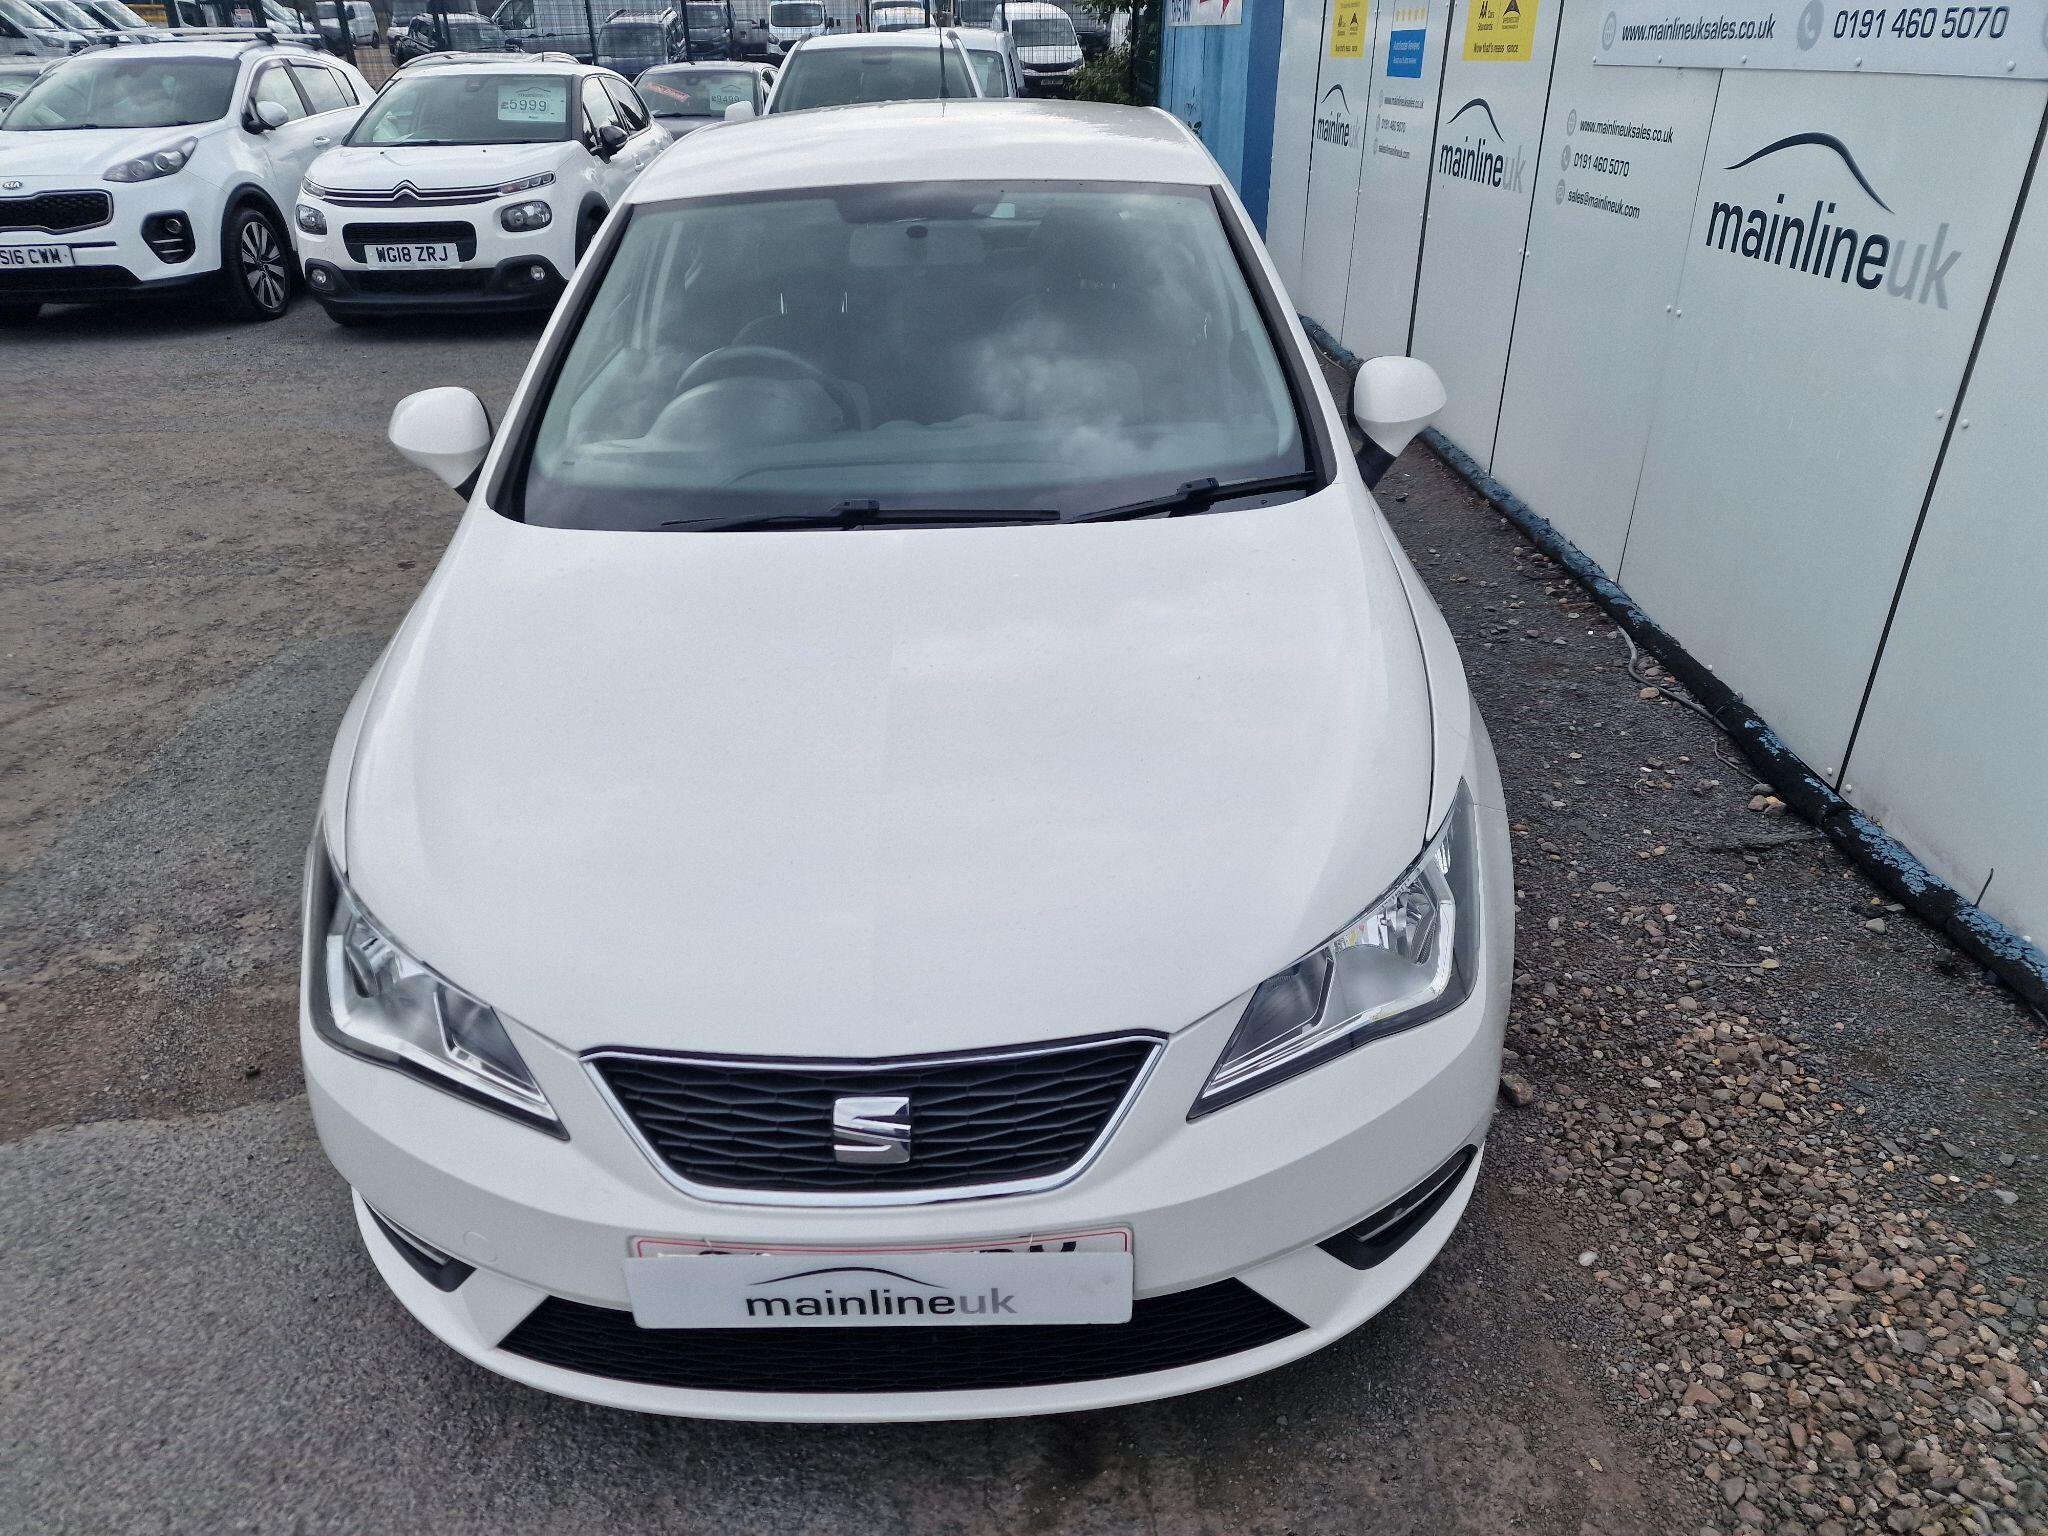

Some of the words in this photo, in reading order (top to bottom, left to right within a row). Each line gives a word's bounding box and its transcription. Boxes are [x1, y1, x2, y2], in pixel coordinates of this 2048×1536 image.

[1621, 13, 1776, 42] www.mainlineuksales.co.uk
[1833, 8, 1887, 39] 0191
[1891, 7, 1937, 39] 460
[1940, 5, 2011, 39] 5070
[500, 98, 548, 112] £5999
[1316, 111, 1361, 150] mainlineuk
[1579, 117, 1674, 144] www.mainlineuksales.co.uk
[1438, 135, 1526, 194] mainlineuk
[1573, 152, 1592, 170] 0191
[1592, 155, 1608, 174] 460
[1608, 157, 1630, 178] 5070
[1567, 187, 1641, 221] sales@mainlineuk.com
[375, 246, 412, 263] WG18
[415, 246, 448, 263] ZRJ
[1705, 193, 1962, 311] mainlineuk
[747, 1287, 1018, 1319] mainlineuk
